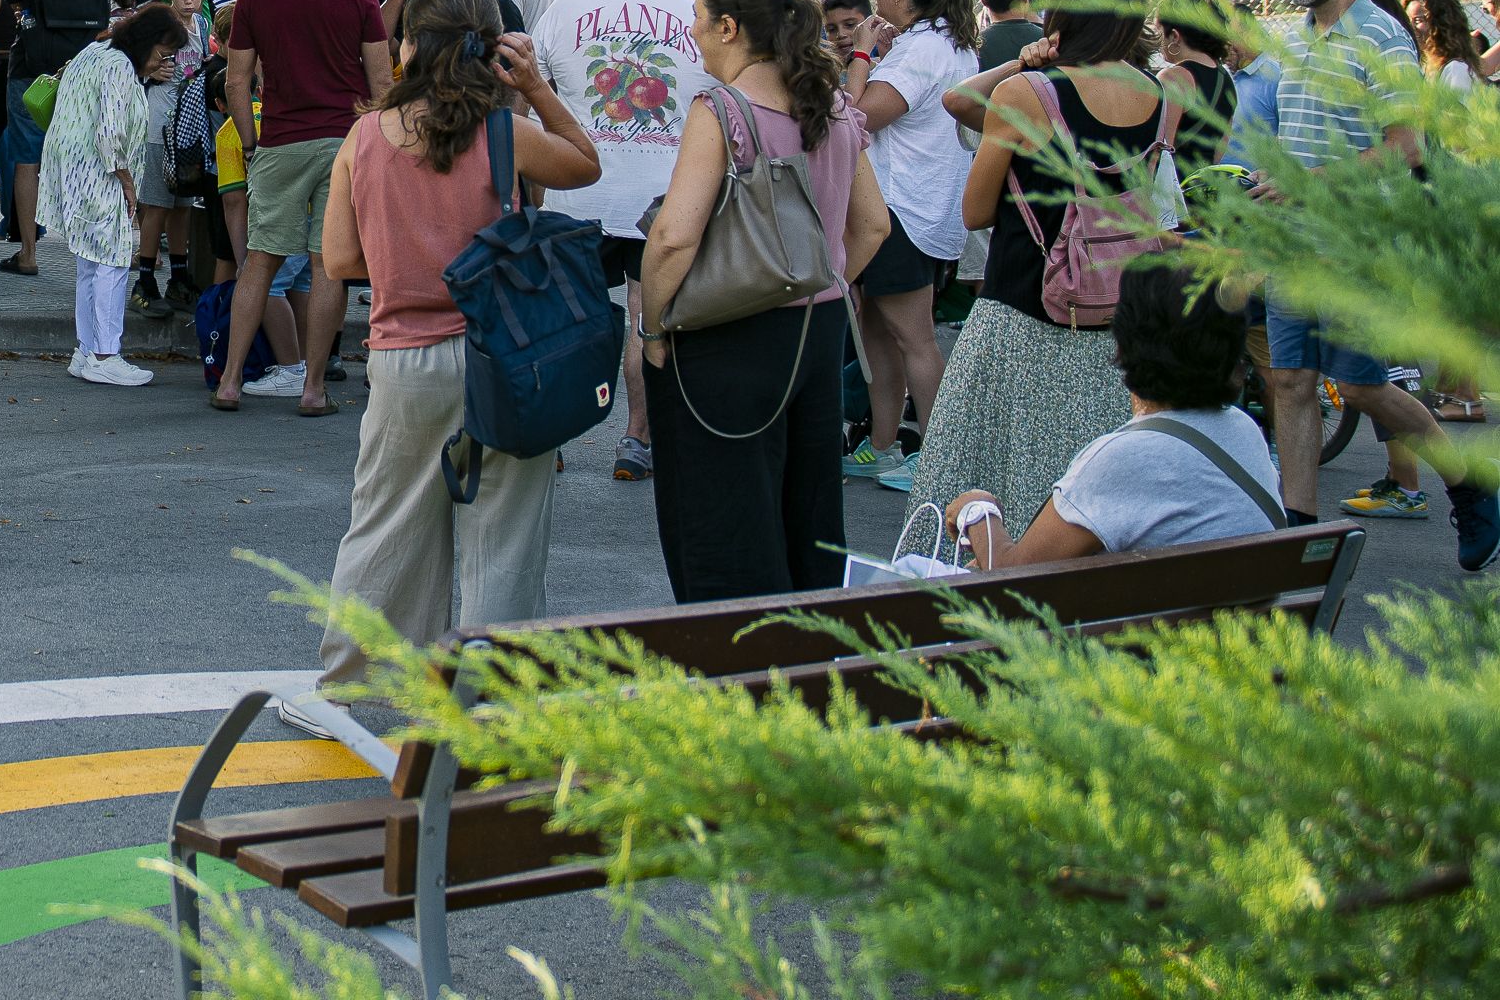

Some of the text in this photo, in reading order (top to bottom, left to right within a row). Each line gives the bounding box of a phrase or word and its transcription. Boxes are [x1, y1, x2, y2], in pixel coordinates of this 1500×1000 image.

[572, 2, 698, 64] PLANES
[579, 27, 685, 55] New York
[580, 116, 682, 143] New York
